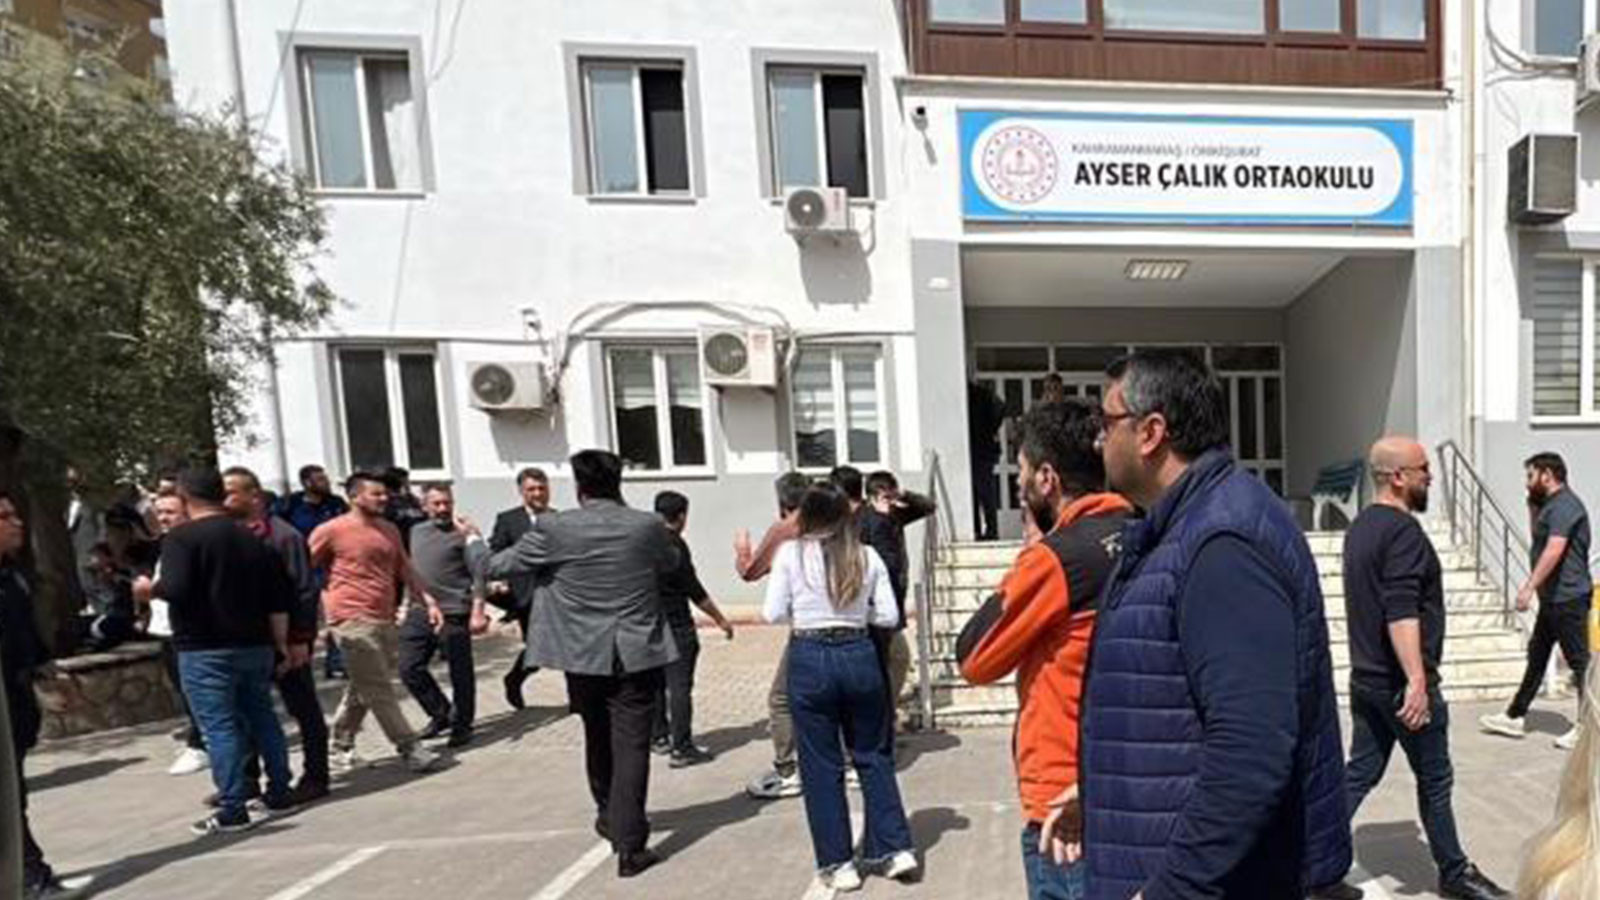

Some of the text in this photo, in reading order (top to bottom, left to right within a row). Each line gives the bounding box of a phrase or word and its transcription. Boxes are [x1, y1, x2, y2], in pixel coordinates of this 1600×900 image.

[1074, 161, 1375, 190] AYSER ÇALIK ORTAOKULU
